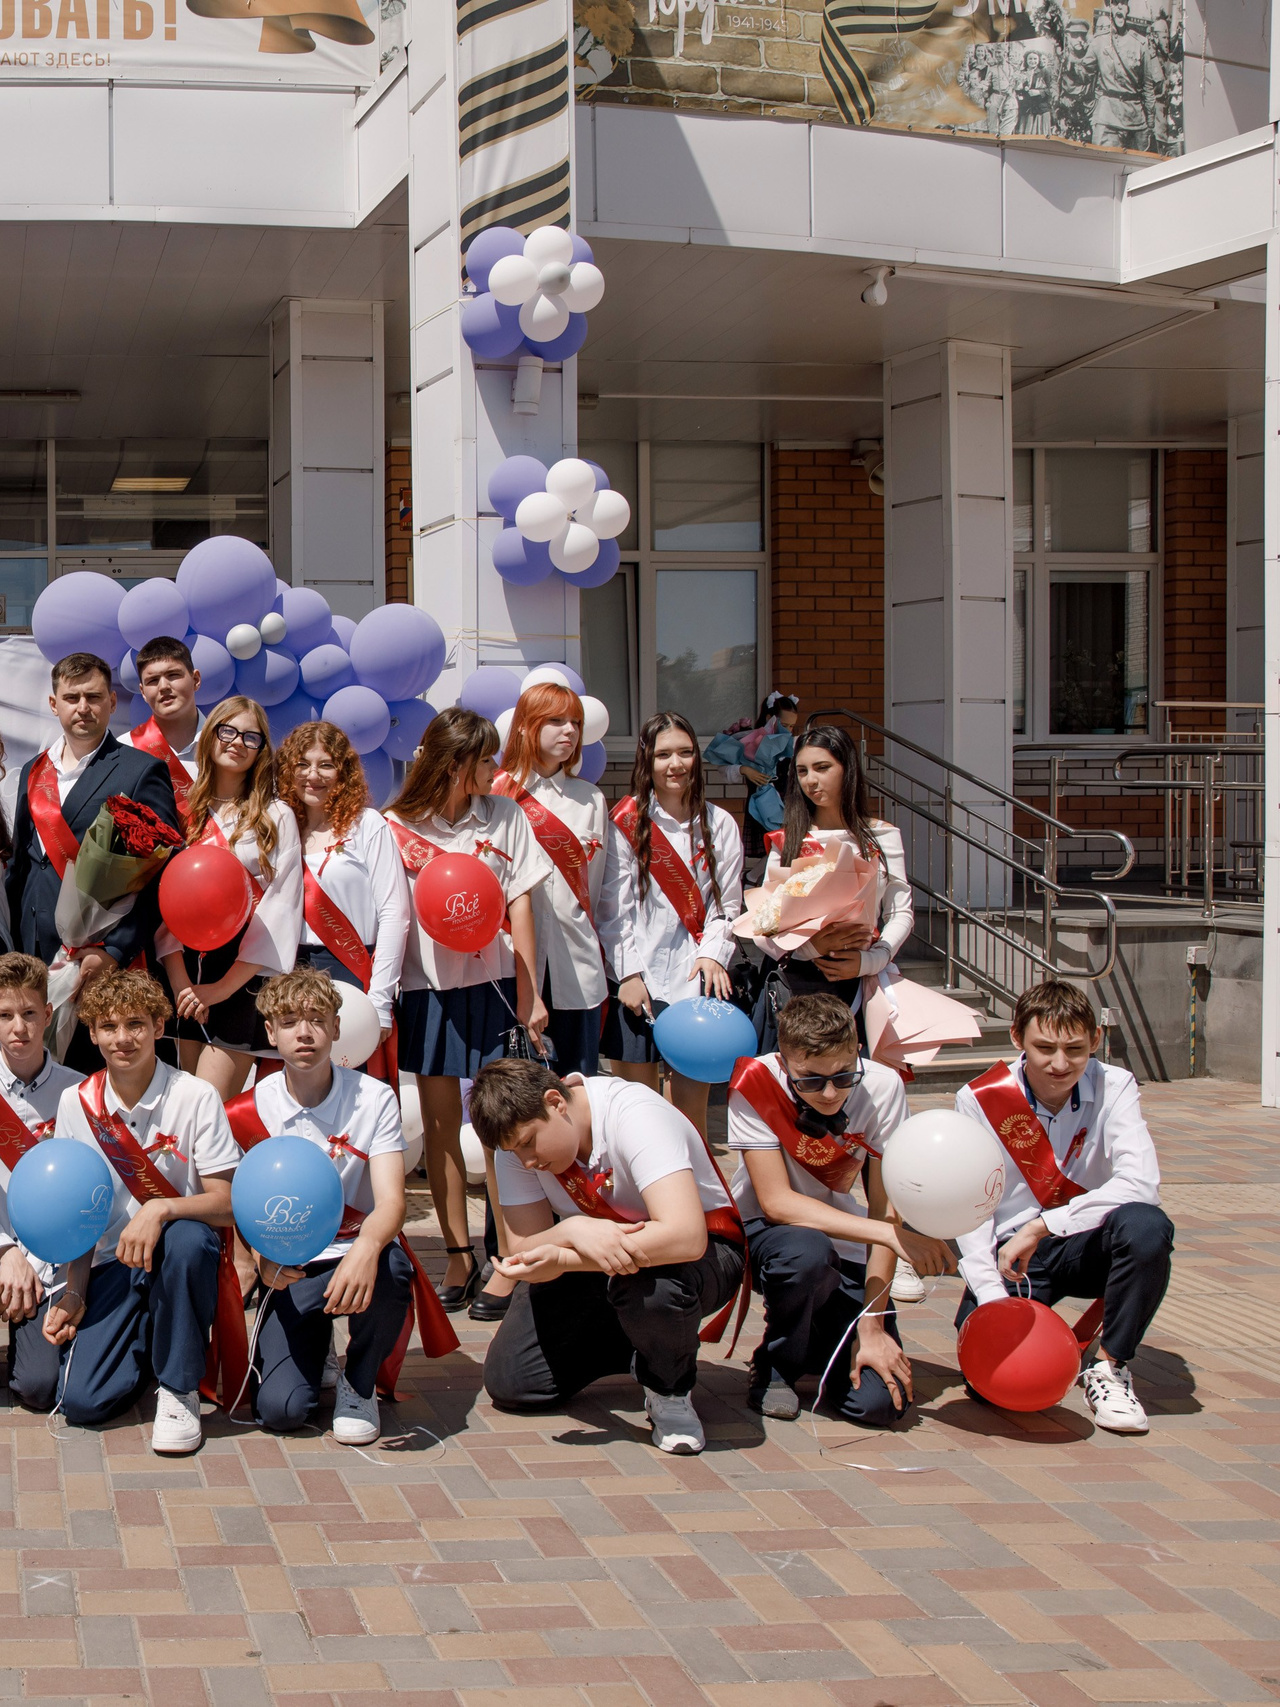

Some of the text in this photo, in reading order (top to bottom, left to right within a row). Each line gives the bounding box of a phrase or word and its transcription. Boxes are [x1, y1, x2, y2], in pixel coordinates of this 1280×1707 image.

[45, 53, 111, 68] ЗДЕСЬ!
[443, 891, 480, 922] Всё
[255, 1195, 313, 1225] Всё
[265, 1222, 306, 1233] только
